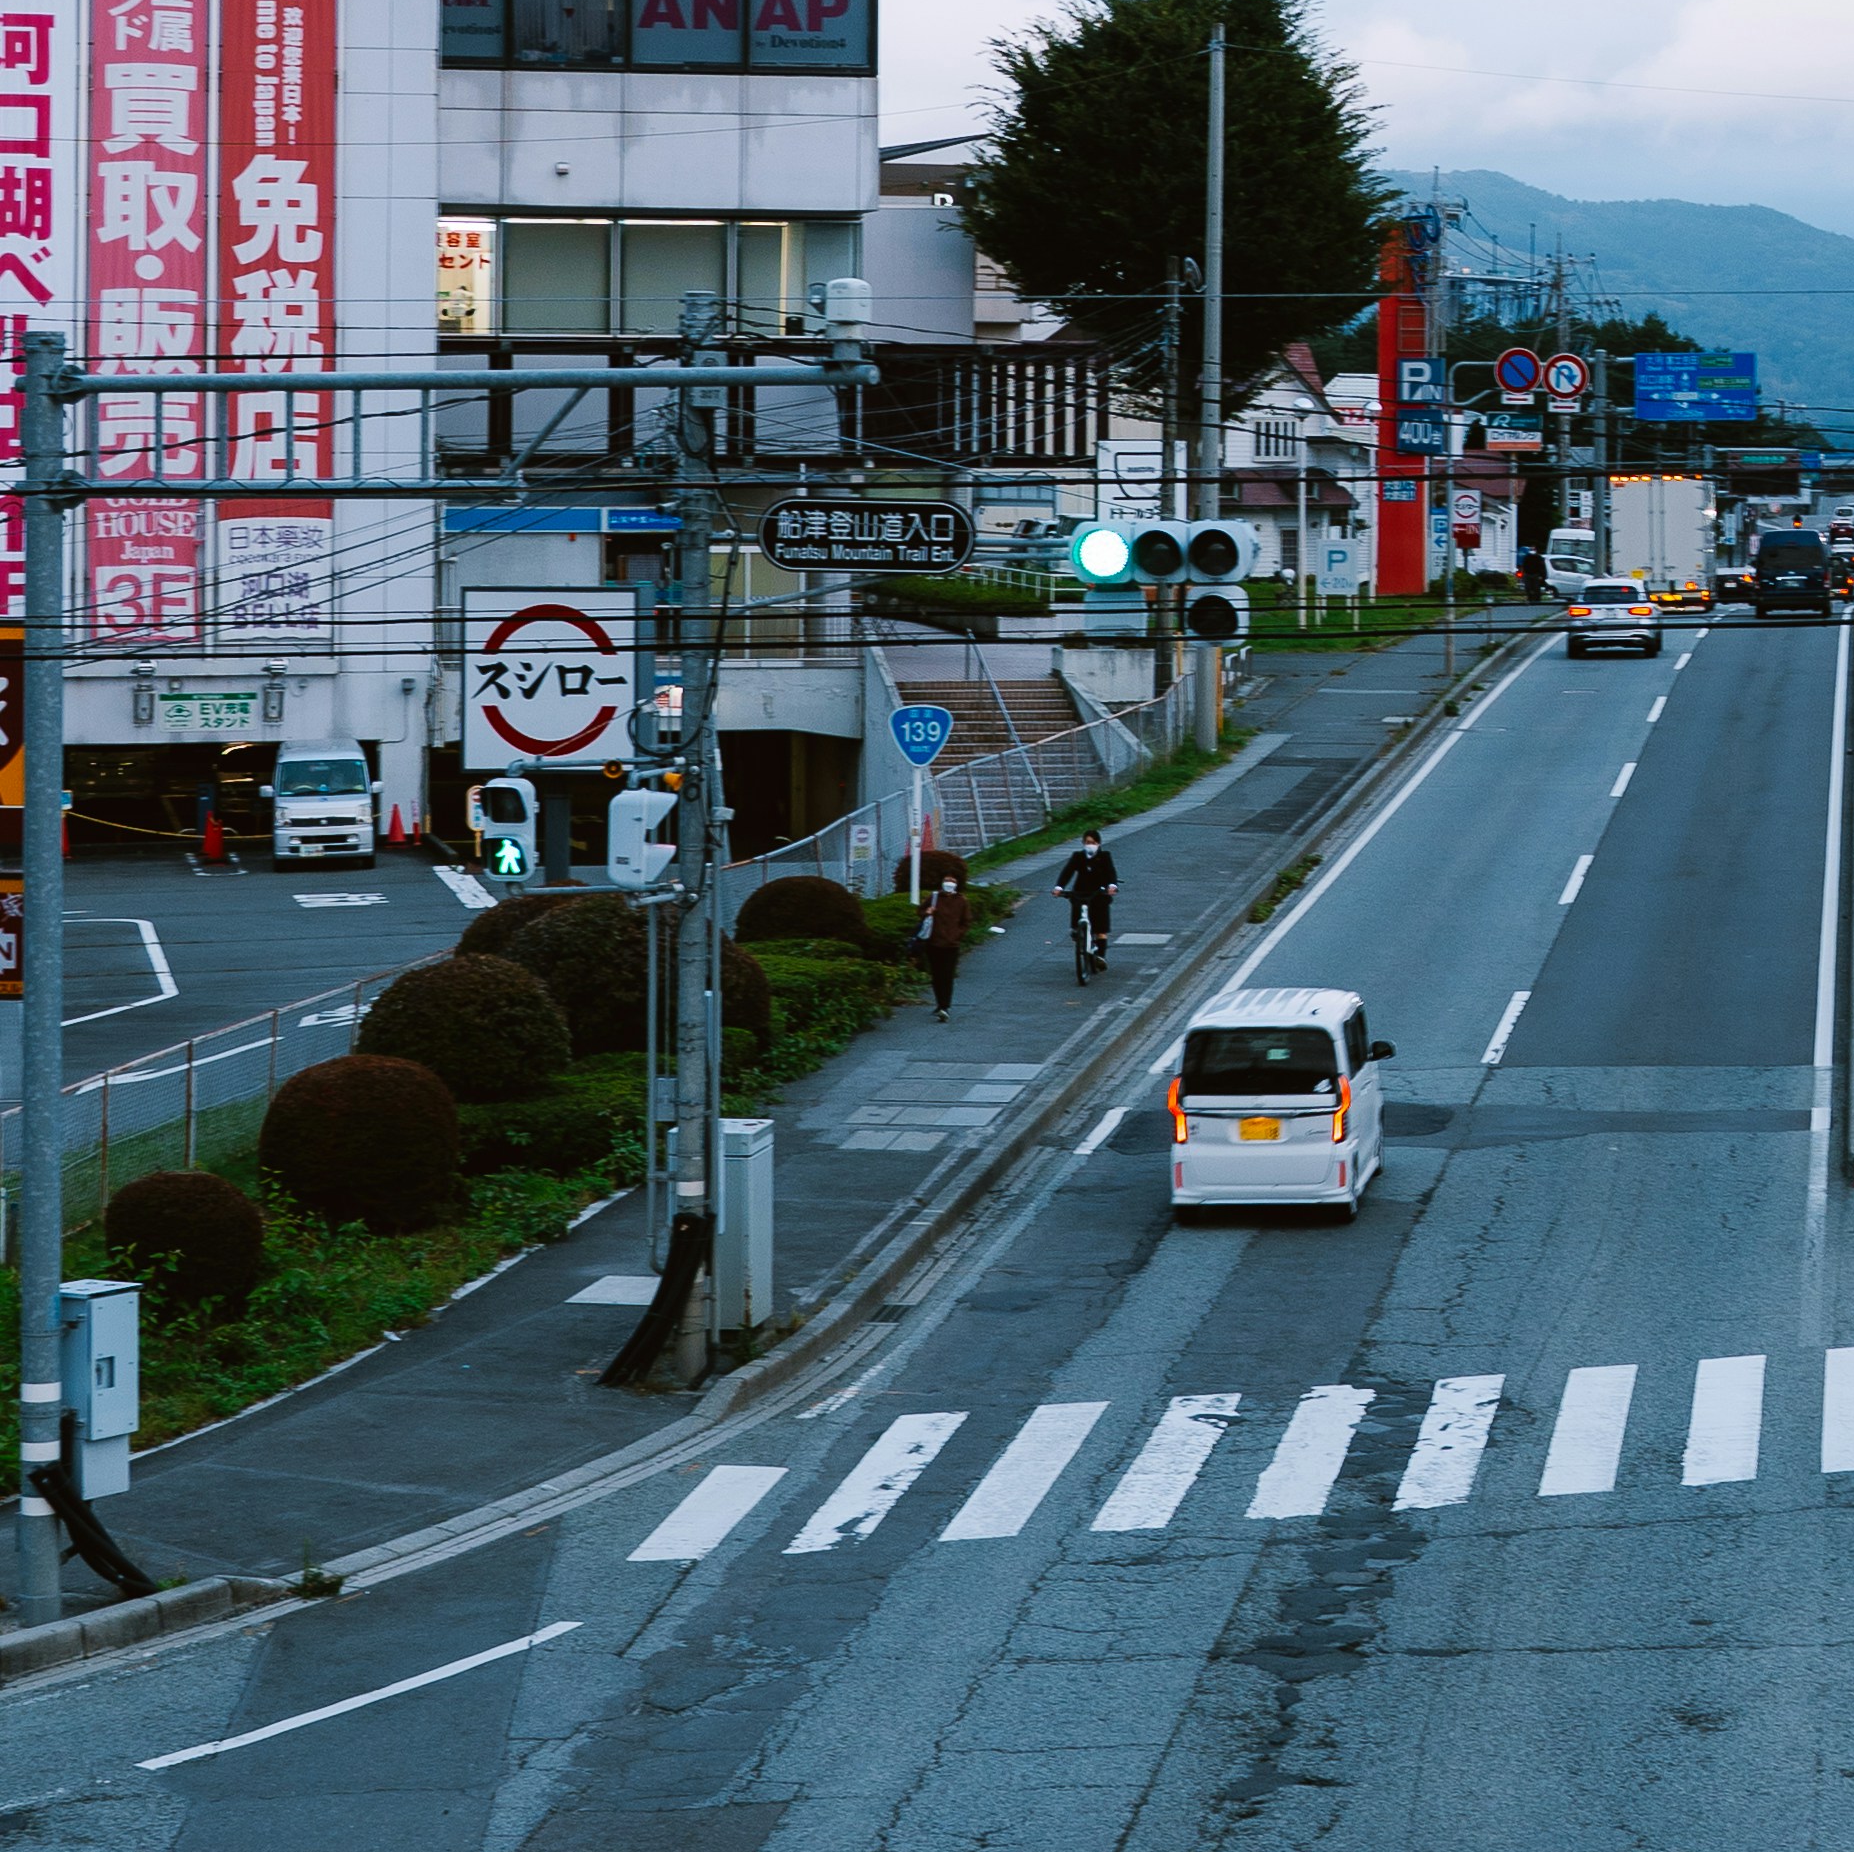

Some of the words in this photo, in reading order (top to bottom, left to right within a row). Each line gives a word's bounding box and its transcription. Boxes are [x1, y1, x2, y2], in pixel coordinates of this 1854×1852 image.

[254, 44, 279, 69] to
[252, 73, 280, 146] Japan
[94, 511, 203, 539] HOUSE
[776, 508, 956, 543] 船津登山道入口
[120, 541, 175, 563] Japan
[775, 543, 829, 559] Funatsu
[831, 545, 893, 561] Mountain
[898, 546, 929, 561] Trail
[1327, 550, 1347, 572] P
[471, 660, 629, 700] スシロー
[199, 717, 251, 730] スタンド
[901, 721, 941, 743] 139
